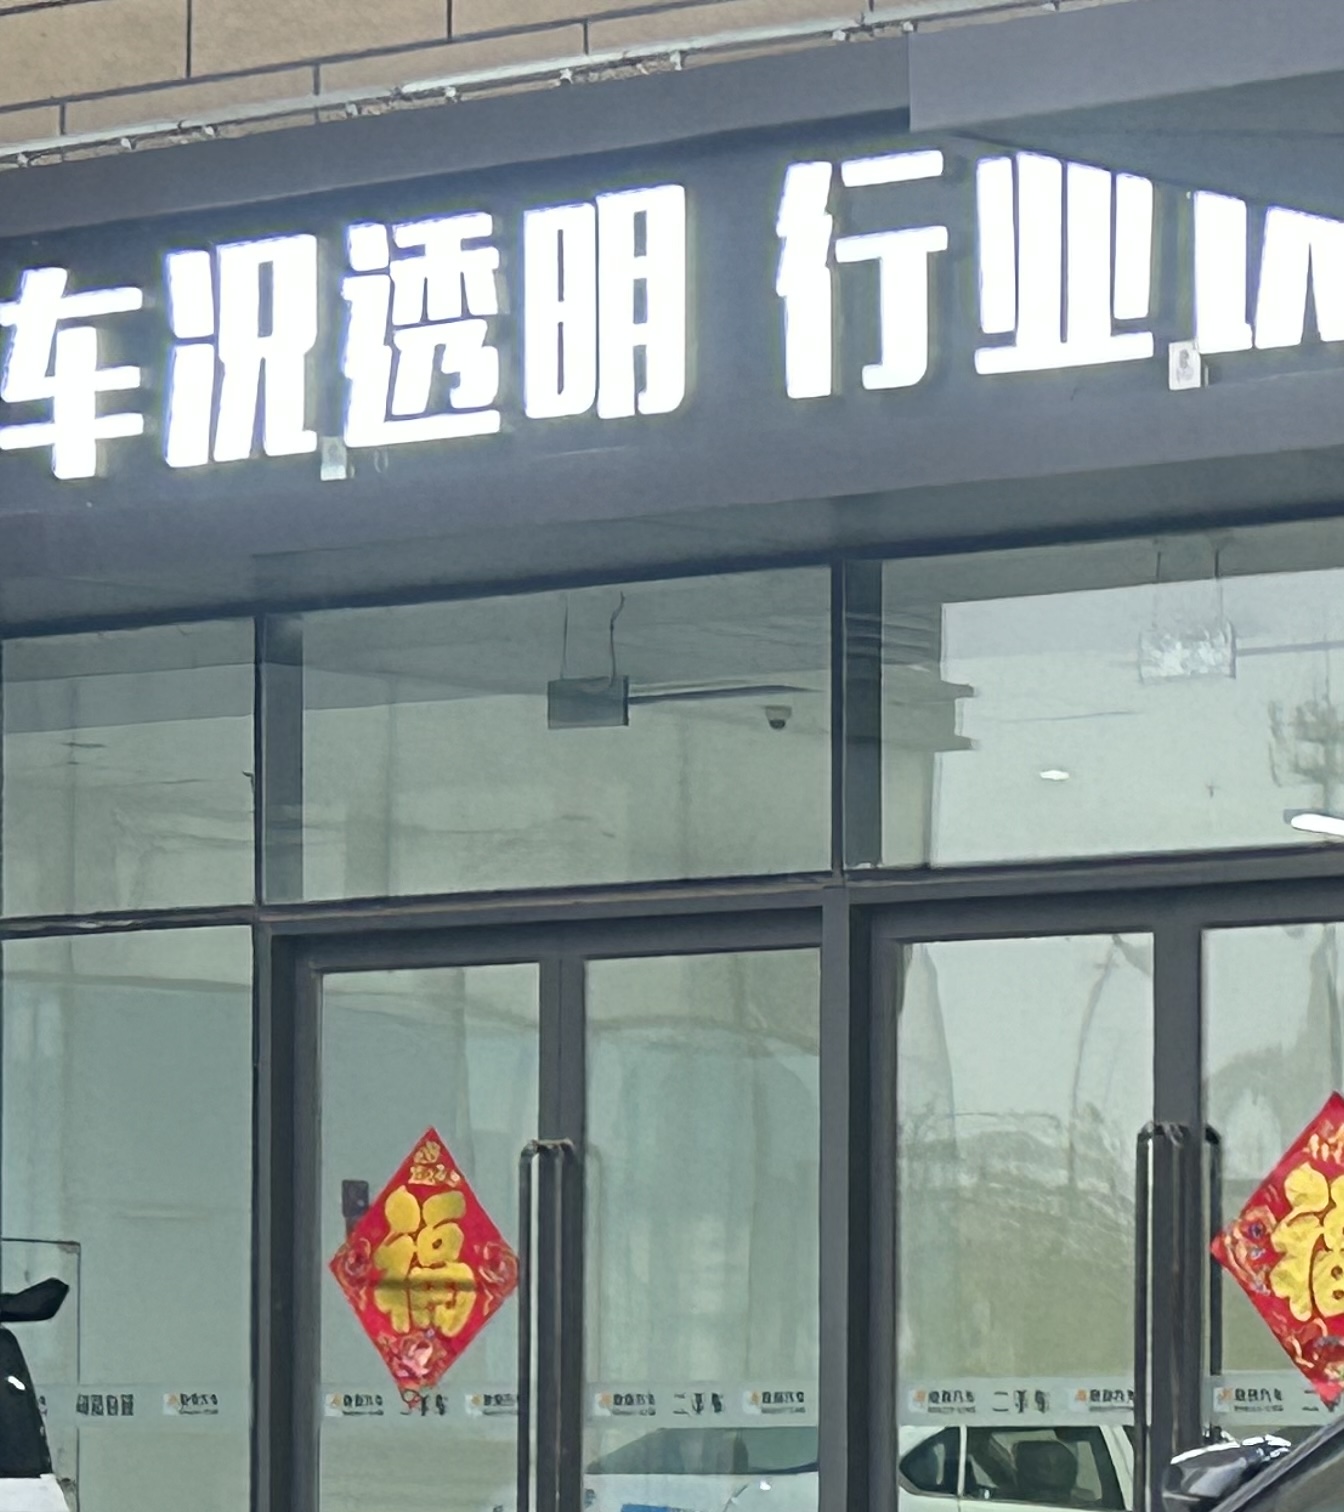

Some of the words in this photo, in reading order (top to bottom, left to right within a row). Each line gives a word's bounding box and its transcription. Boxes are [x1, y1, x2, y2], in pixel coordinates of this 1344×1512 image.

[0, 183, 688, 480] 车况透明
[373, 1184, 477, 1338] 福
